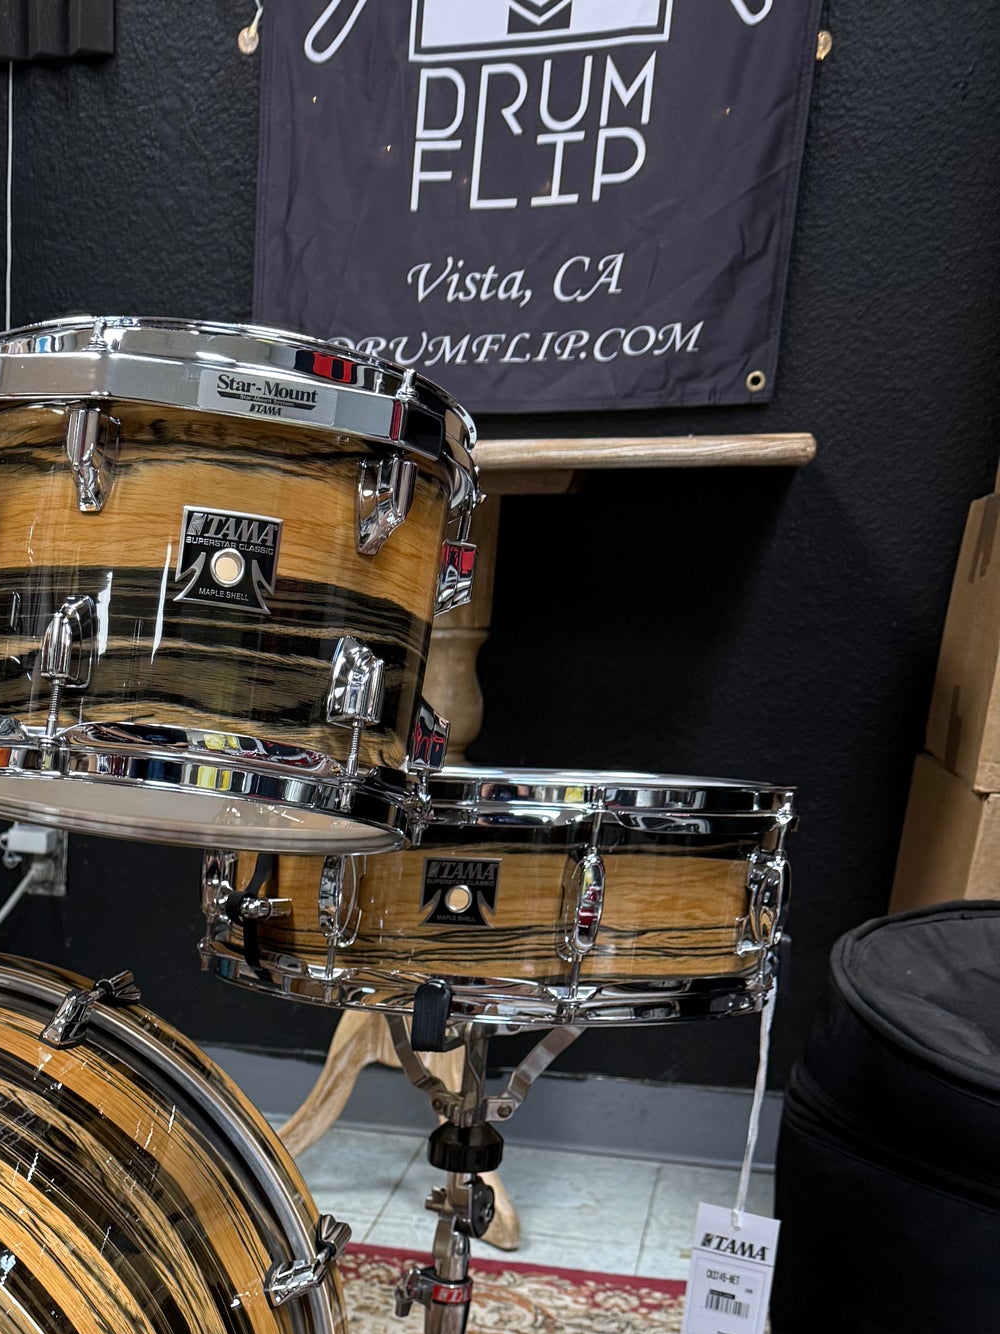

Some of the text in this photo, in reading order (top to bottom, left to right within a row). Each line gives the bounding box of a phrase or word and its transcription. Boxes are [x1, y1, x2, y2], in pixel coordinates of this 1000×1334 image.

[416, 51, 657, 138] DRUM
[410, 128, 647, 211] FLIP
[408, 252, 626, 307] Vista, CA
[217, 374, 319, 403] Star-Mount
[256, 404, 283, 416] TAMA
[186, 536, 274, 556] SUPERSTAR CLASSIC
[199, 587, 249, 602] MAPLE SHELL
[440, 862, 495, 880] TAMA
[715, 1234, 768, 1261] TAMA
